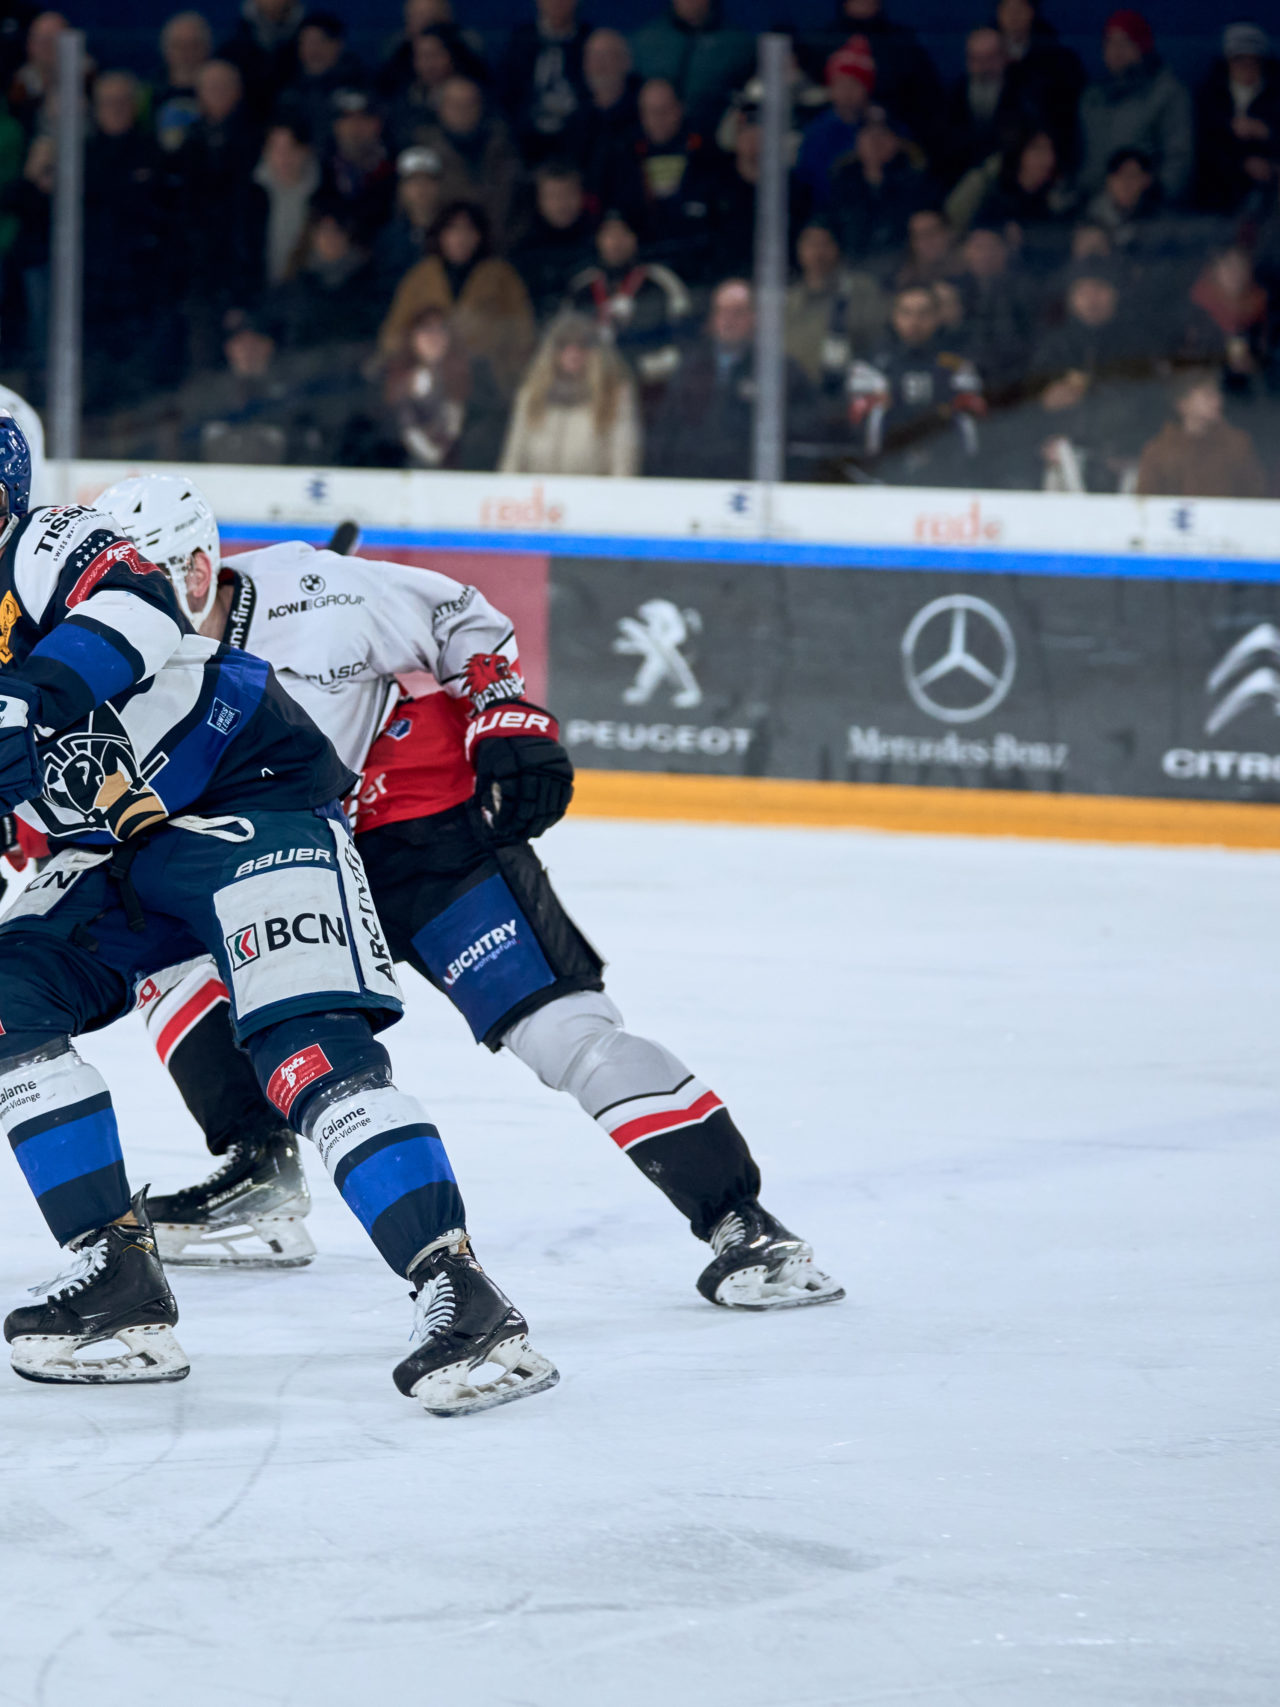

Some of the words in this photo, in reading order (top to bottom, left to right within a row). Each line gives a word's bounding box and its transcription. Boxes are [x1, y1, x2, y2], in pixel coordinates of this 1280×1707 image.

[267, 602, 299, 621] ACW
[565, 719, 754, 756] PEUGEOT
[847, 725, 1069, 772] Mercedes-Benz
[24, 870, 79, 894] CN
[264, 913, 348, 952] BCN
[322, 1107, 367, 1141] Calame
